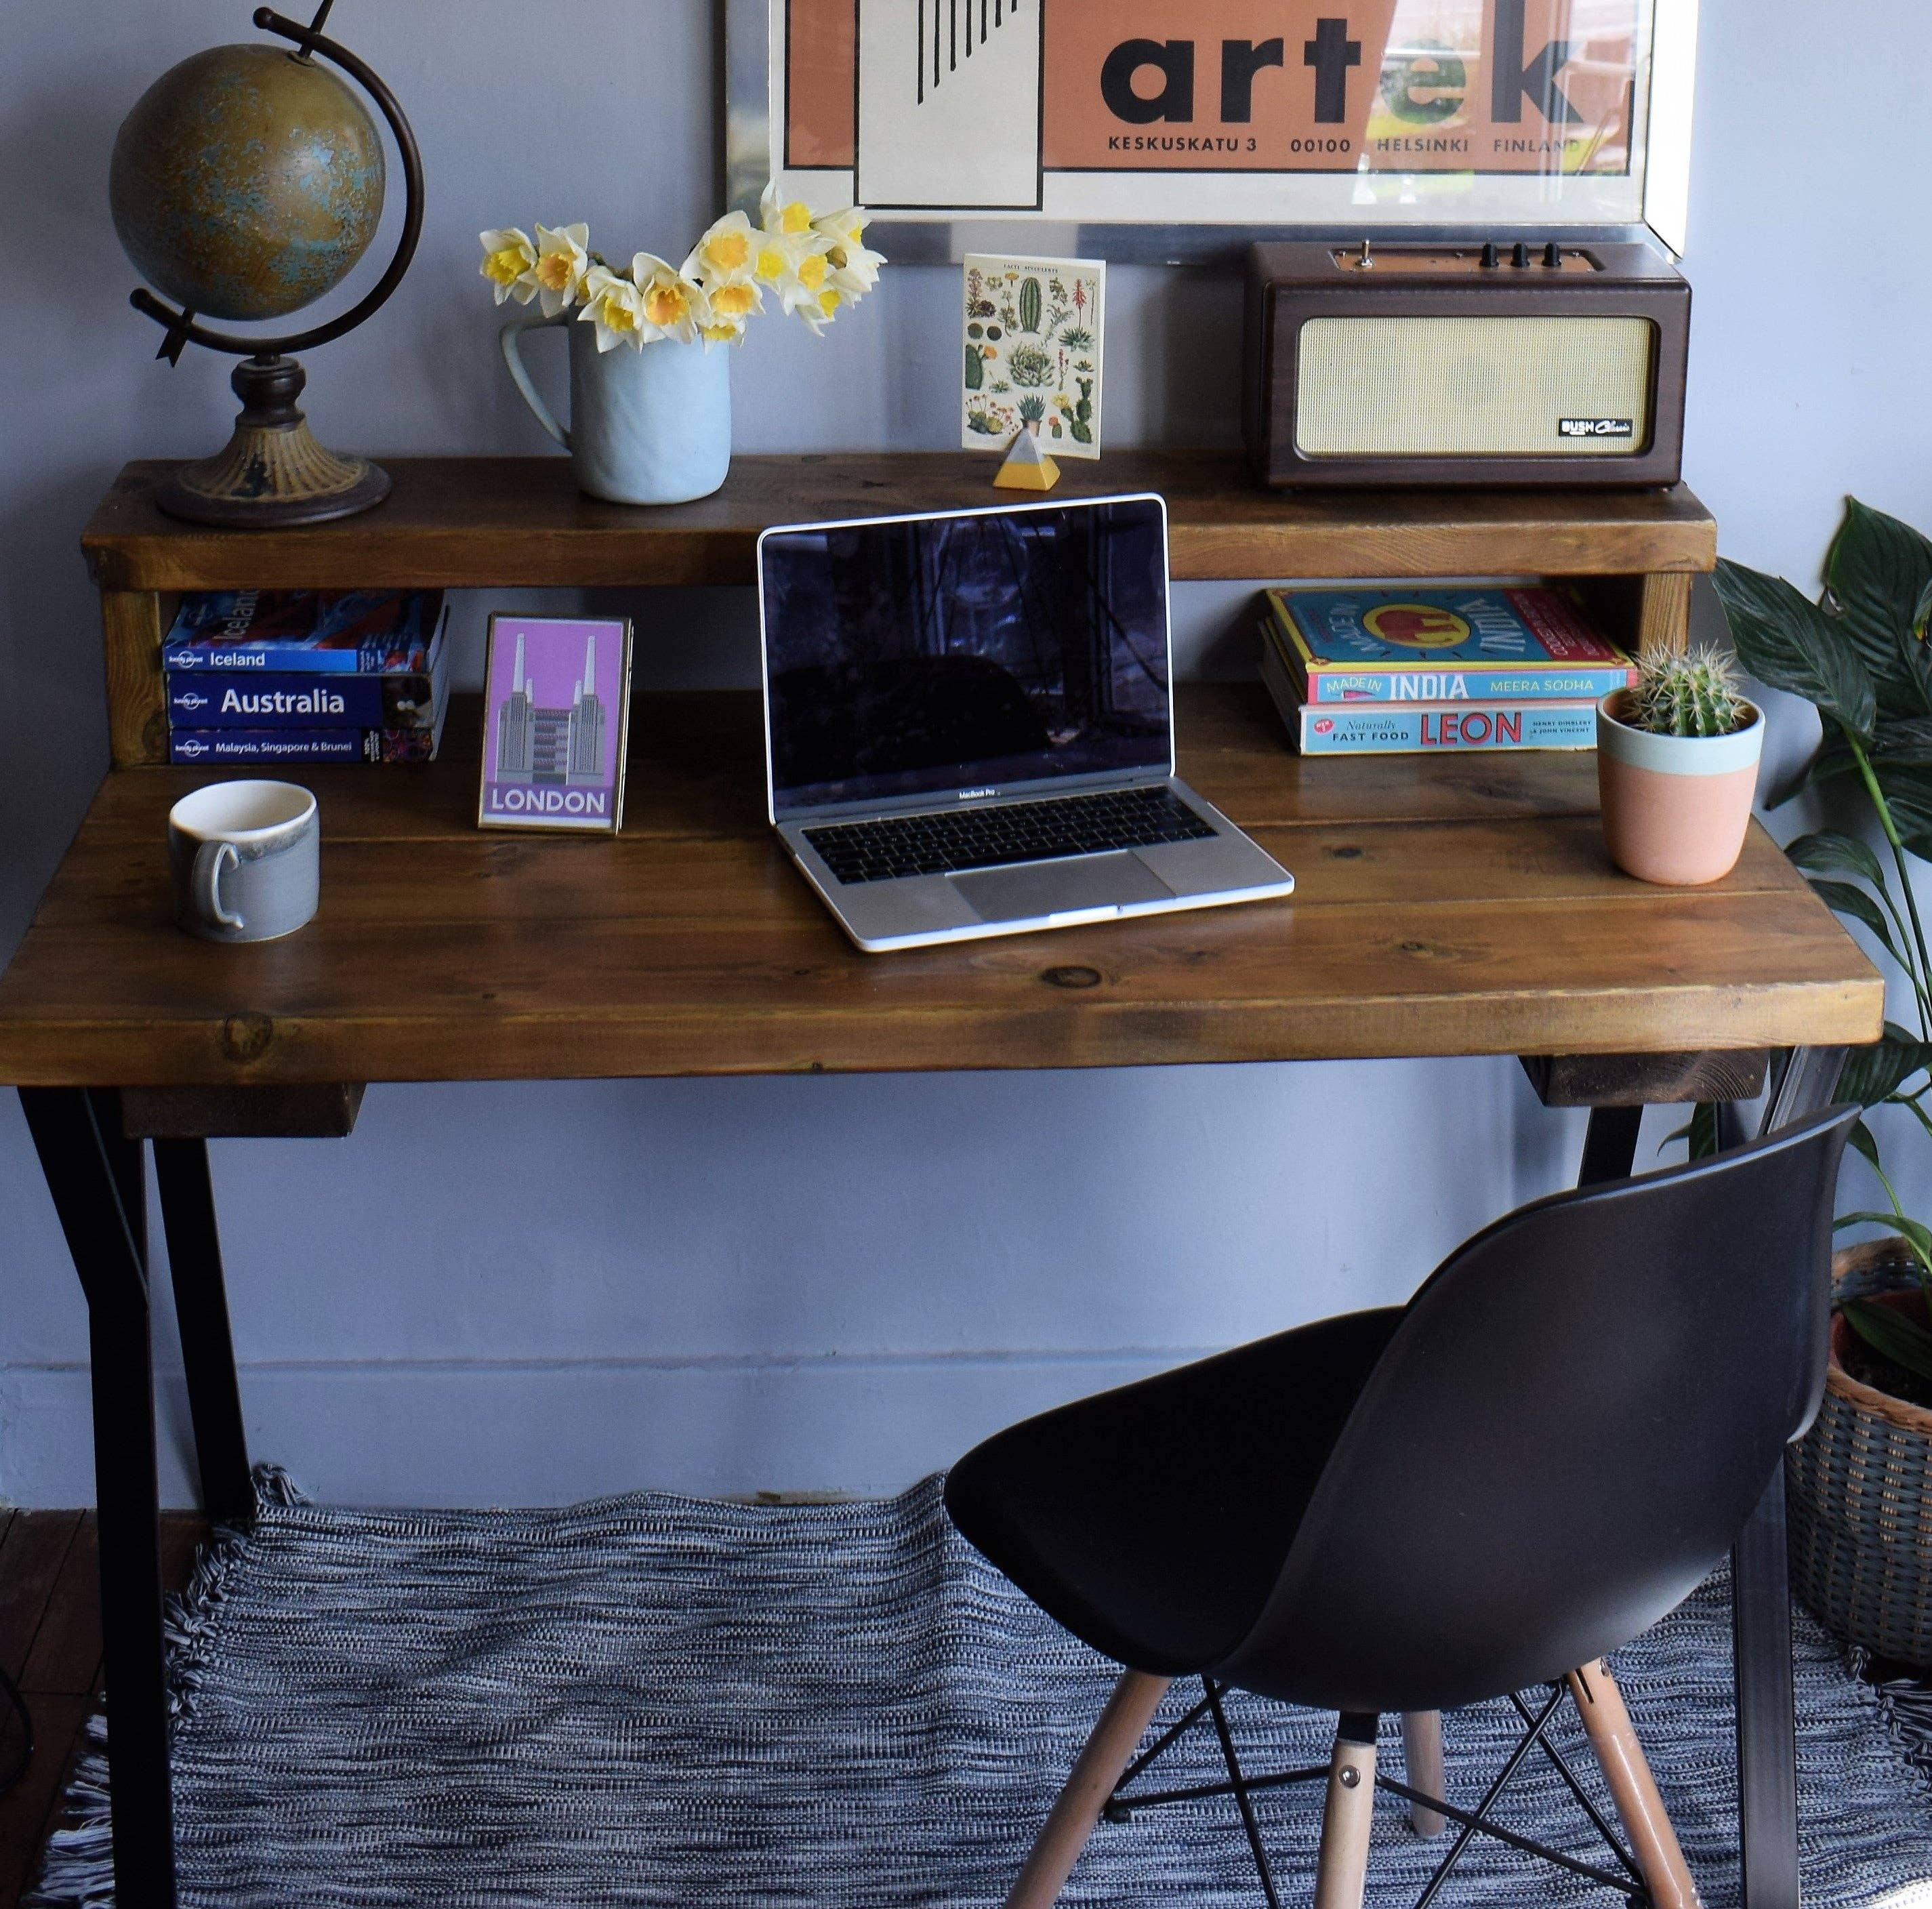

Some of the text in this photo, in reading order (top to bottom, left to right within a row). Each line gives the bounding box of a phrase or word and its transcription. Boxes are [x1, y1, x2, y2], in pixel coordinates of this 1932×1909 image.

[1100, 0, 1584, 124] artek
[1109, 136, 1580, 153] KESKUSKATU 3 00100 HELSINKI FINLAND
[1561, 420, 1594, 432] BUSH
[210, 652, 266, 667] Iceland
[1326, 674, 1470, 700] MADE IN INDIA
[1490, 679, 1594, 692] MEERA SODHA
[221, 689, 344, 713] Australia
[1332, 731, 1410, 742] FAST FOOD
[1421, 712, 1522, 745] LEON
[215, 741, 352, 755] Malaysia, Singapore & Brunei
[492, 787, 605, 813] LONDON
